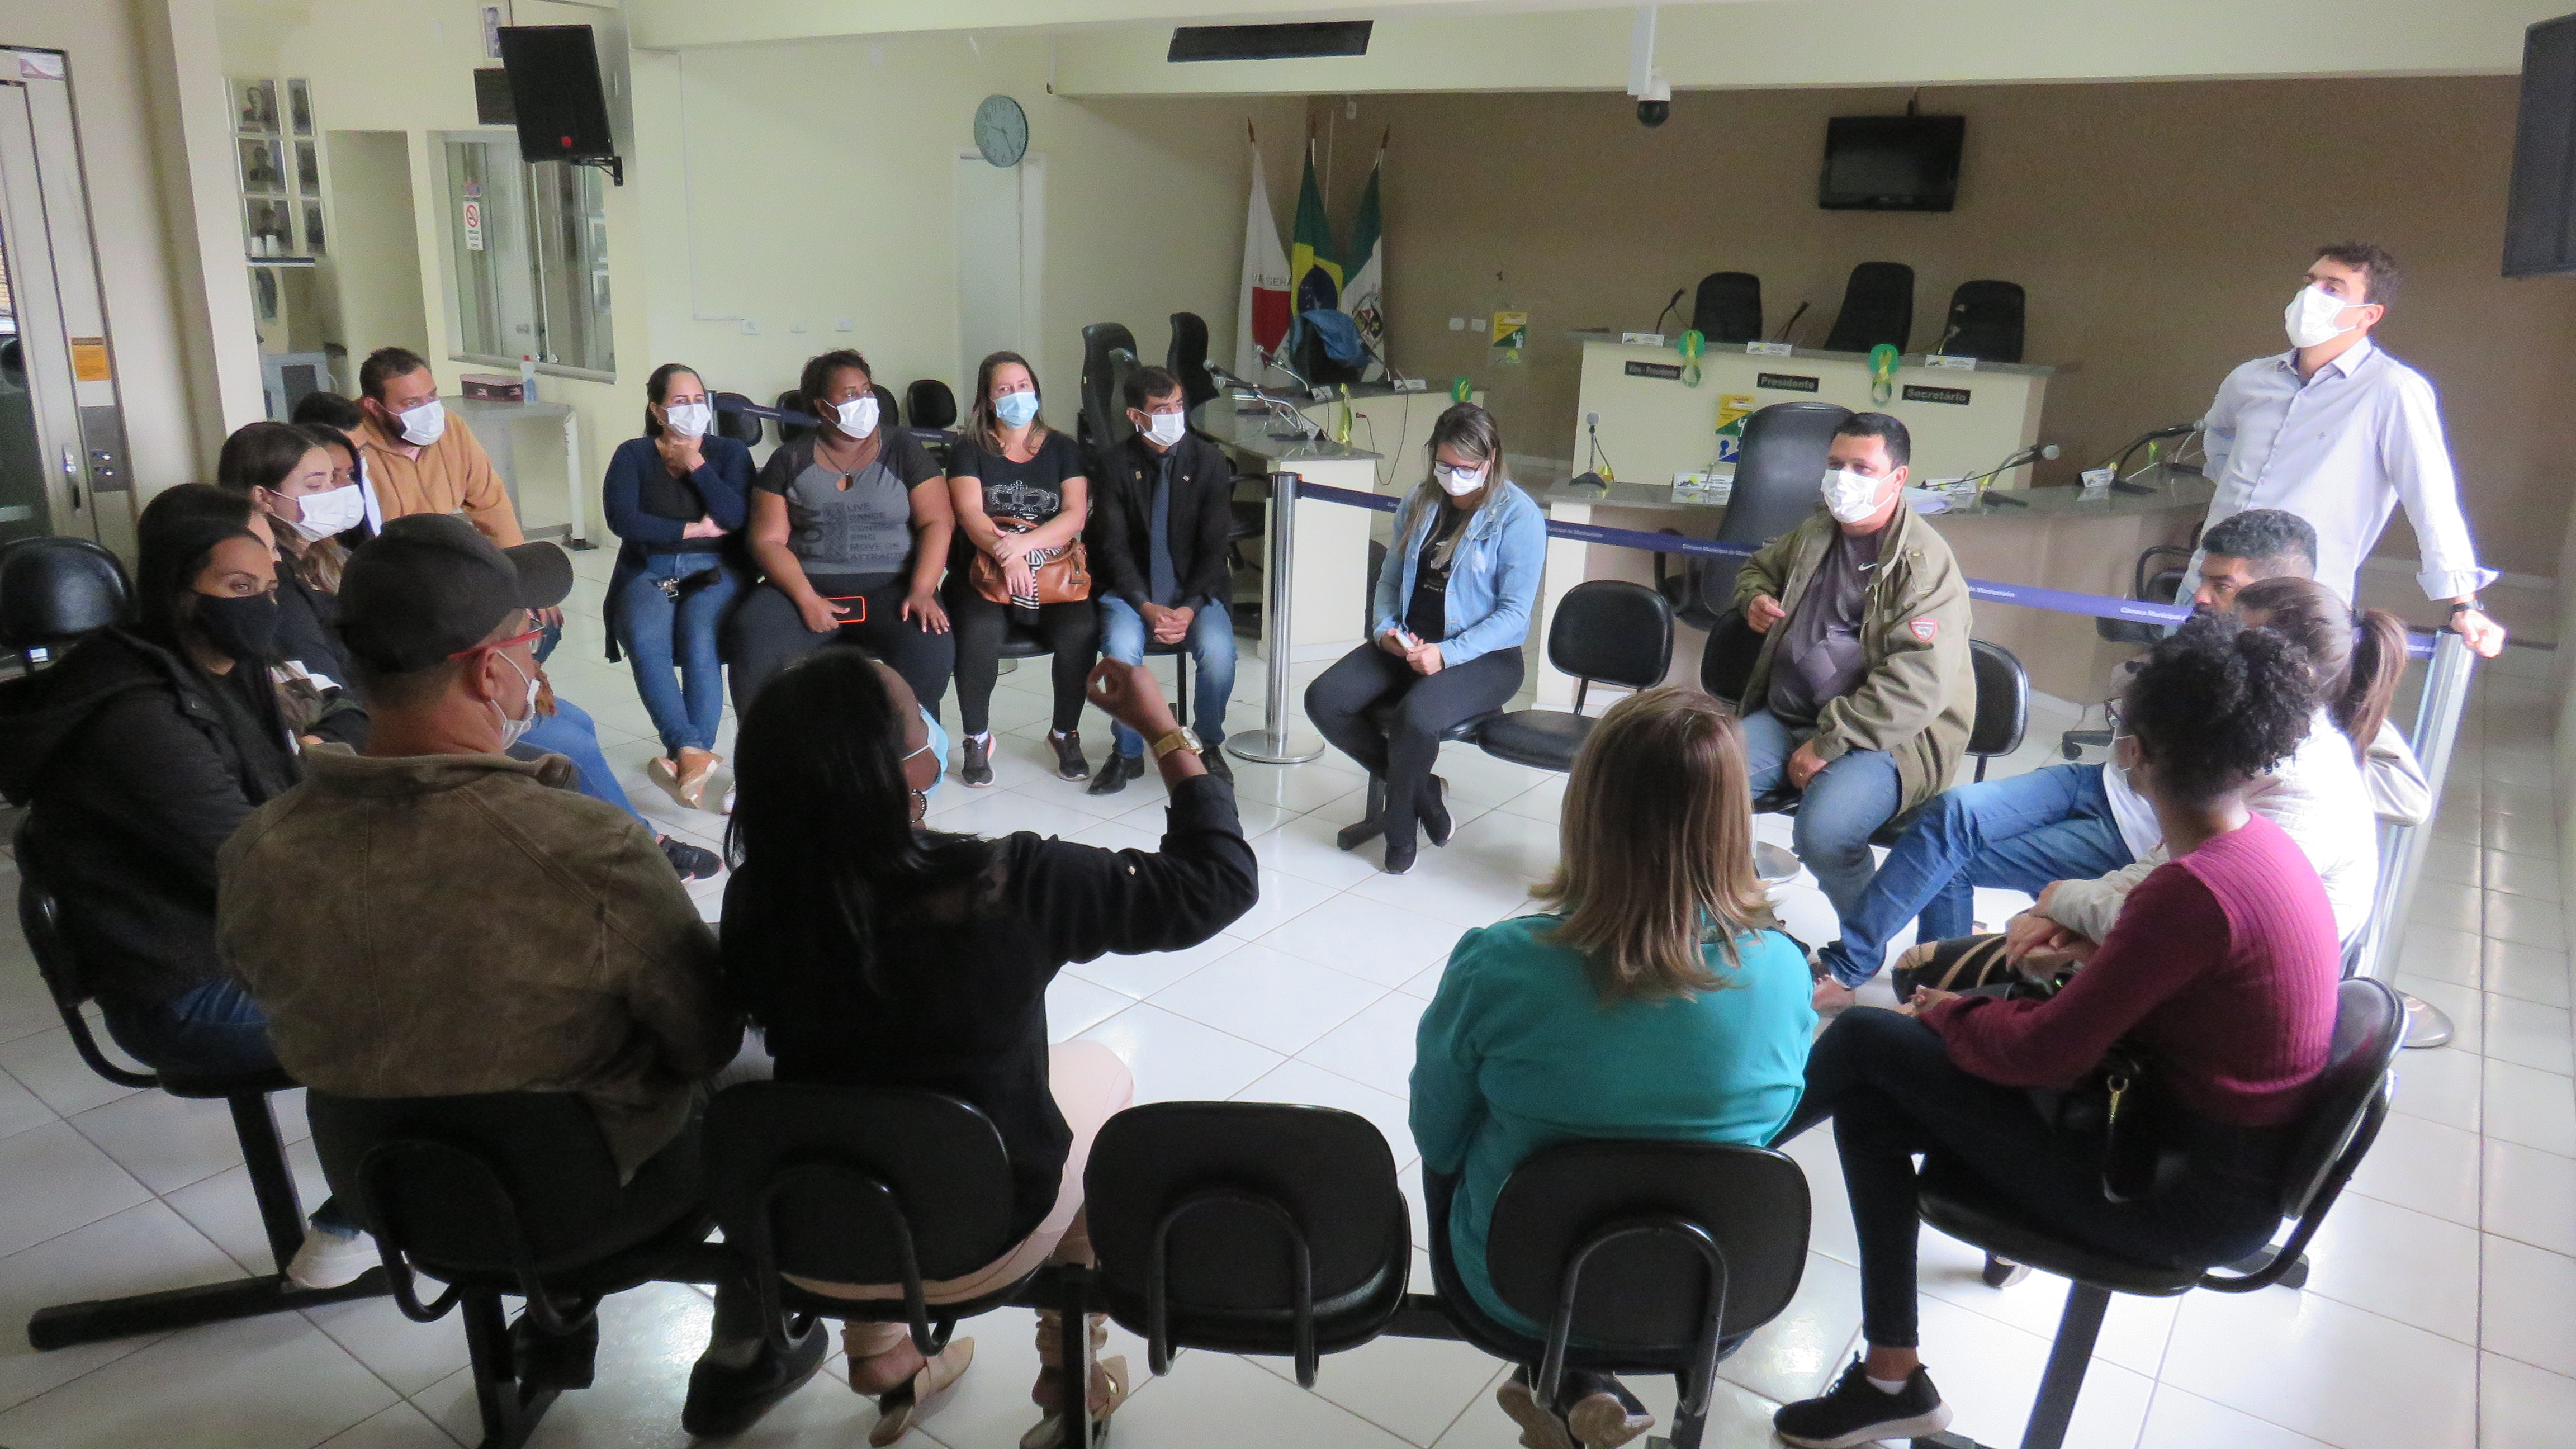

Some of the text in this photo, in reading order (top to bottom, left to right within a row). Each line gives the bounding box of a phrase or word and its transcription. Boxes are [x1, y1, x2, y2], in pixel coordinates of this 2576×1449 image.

[1761, 376, 1815, 389] Presidente
[1906, 388, 1967, 402] Secretário
[847, 503, 870, 512] LIVE
